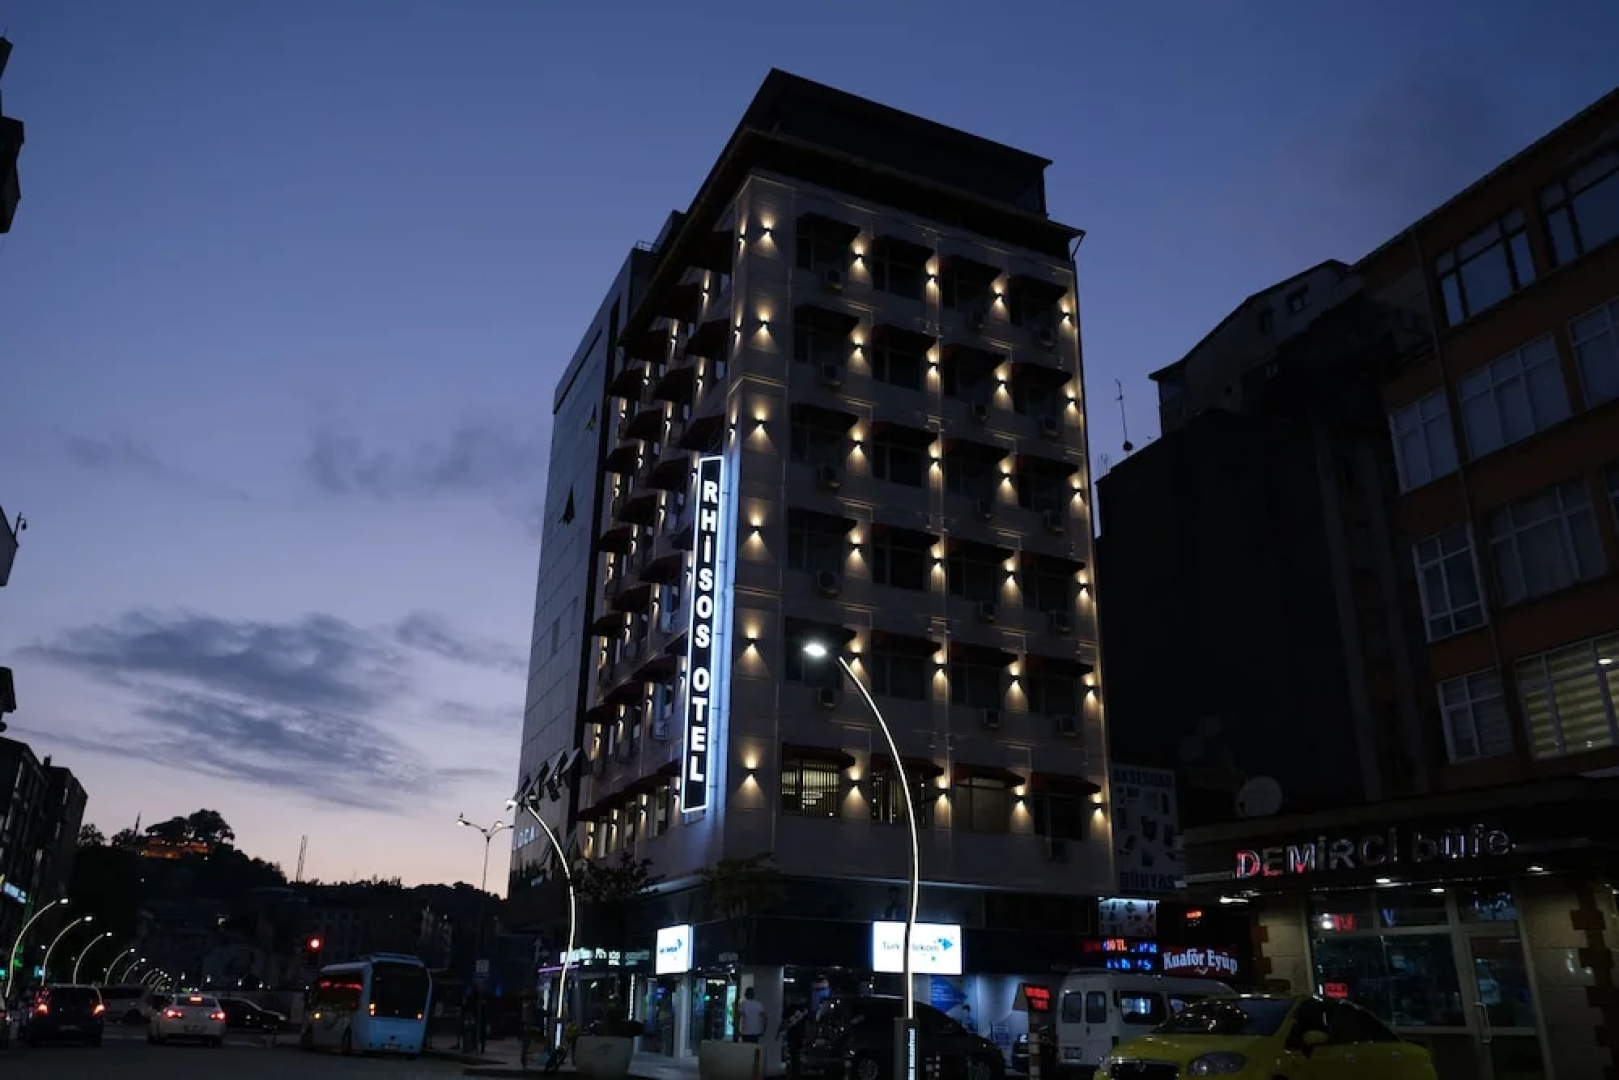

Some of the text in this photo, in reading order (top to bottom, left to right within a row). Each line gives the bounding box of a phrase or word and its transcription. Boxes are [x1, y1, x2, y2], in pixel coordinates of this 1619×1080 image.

[689, 666, 710, 783] OTEL
[1163, 947, 1205, 971] Kuaför
[1206, 949, 1238, 975] Eyüp
